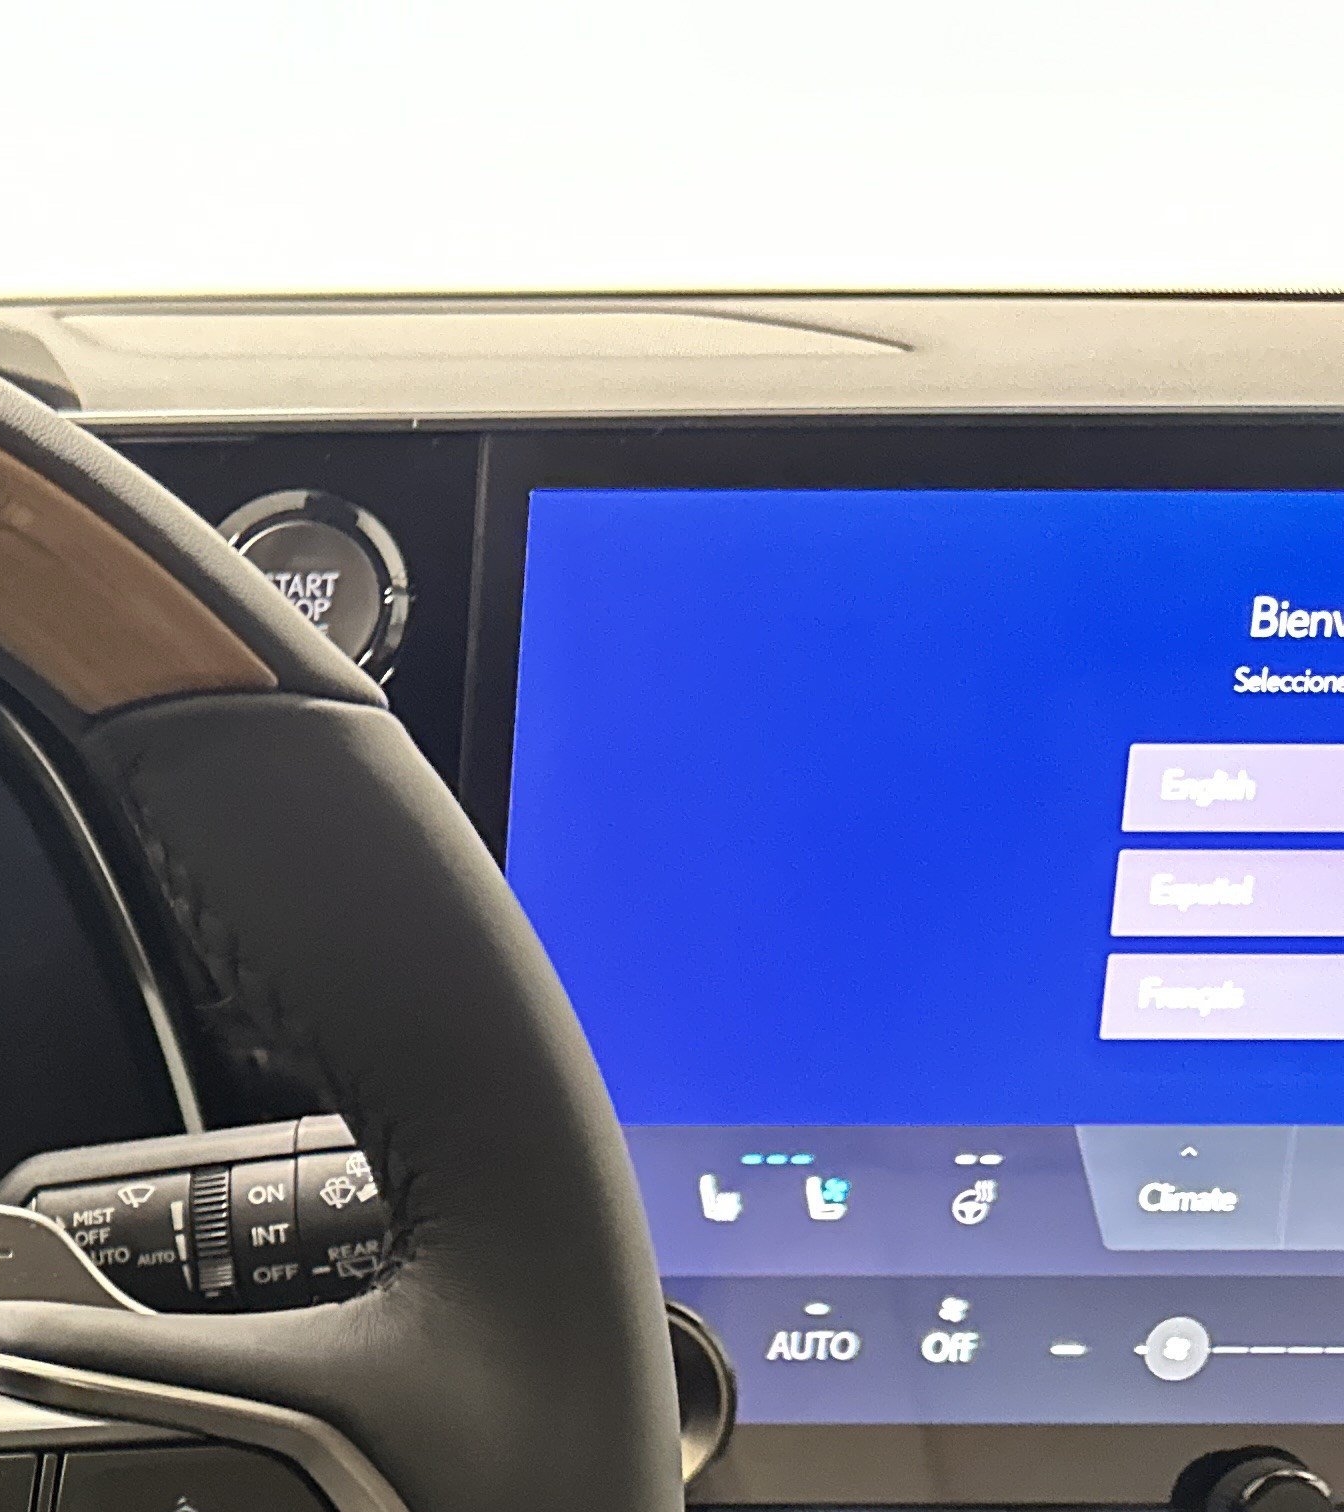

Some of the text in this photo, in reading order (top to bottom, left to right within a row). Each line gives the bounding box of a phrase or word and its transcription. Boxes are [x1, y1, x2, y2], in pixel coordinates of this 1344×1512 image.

[265, 571, 340, 598] TART
[247, 1183, 286, 1206] ON
[1138, 1182, 1238, 1214] Climate
[72, 1207, 115, 1227] MIST
[251, 1224, 289, 1248] INT
[91, 1247, 131, 1266] UTO
[137, 1249, 175, 1267] AUTO
[327, 1239, 381, 1262] REAR
[253, 1262, 300, 1286] OFF
[766, 1329, 858, 1362] AUTO
[920, 1331, 977, 1364] Off
